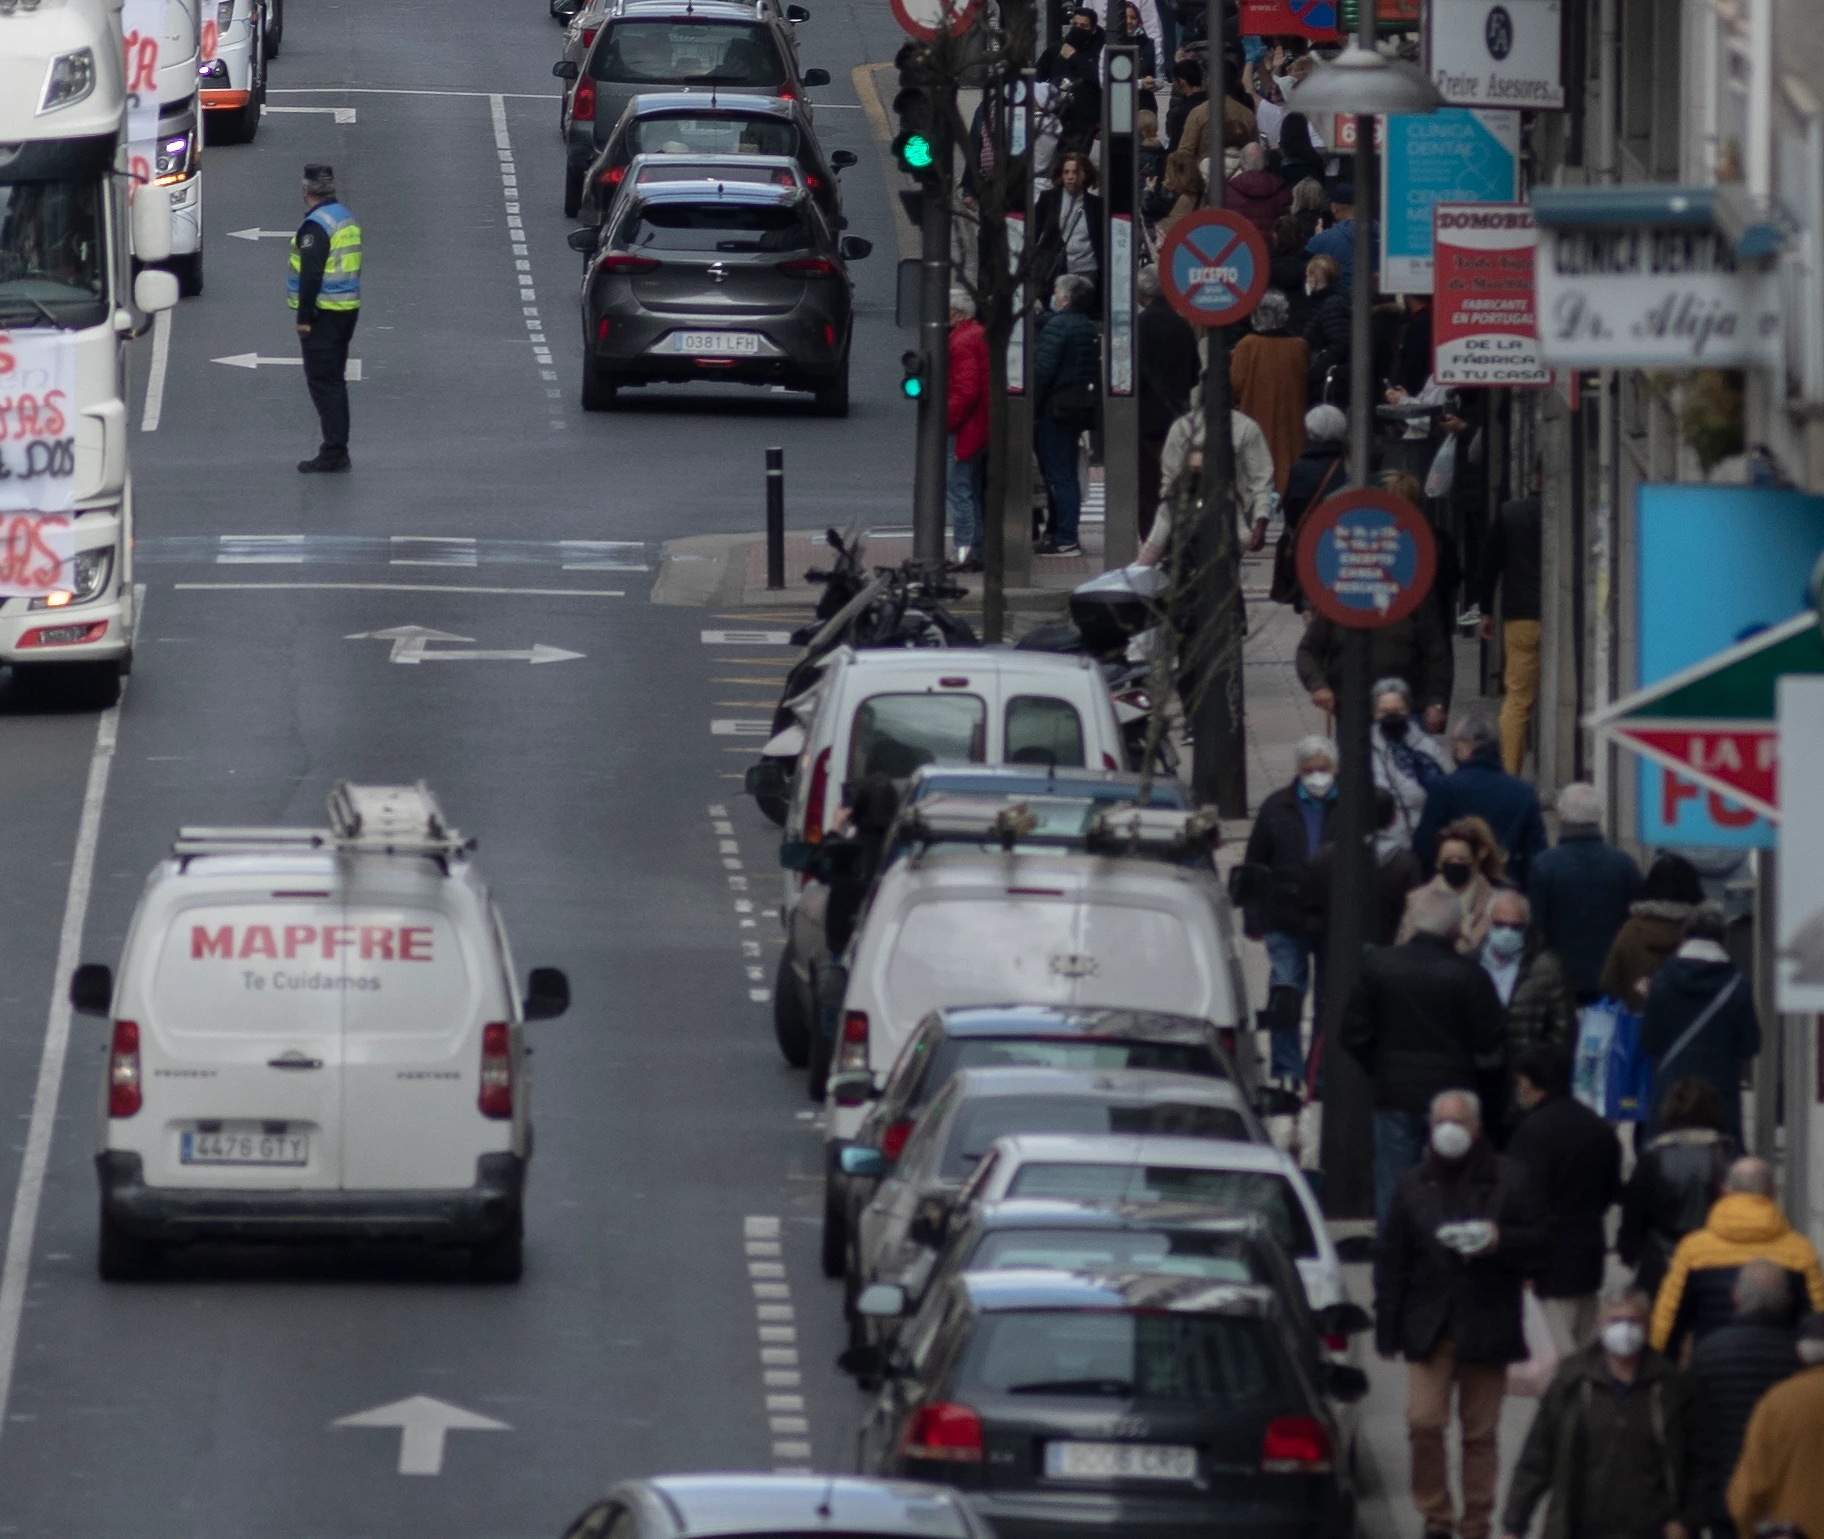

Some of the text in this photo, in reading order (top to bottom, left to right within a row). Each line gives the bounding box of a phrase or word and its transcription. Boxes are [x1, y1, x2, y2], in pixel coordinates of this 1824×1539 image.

[686, 334, 755, 350] 0381 LFH
[1465, 339, 1522, 350] DE LA
[1452, 352, 1536, 365] FÁBRICA
[1442, 370, 1546, 379] A TU CASA
[190, 923, 434, 962] MAPFRE
[242, 970, 382, 992] Te Cuidamos
[260, 1136, 302, 1159] GTY
